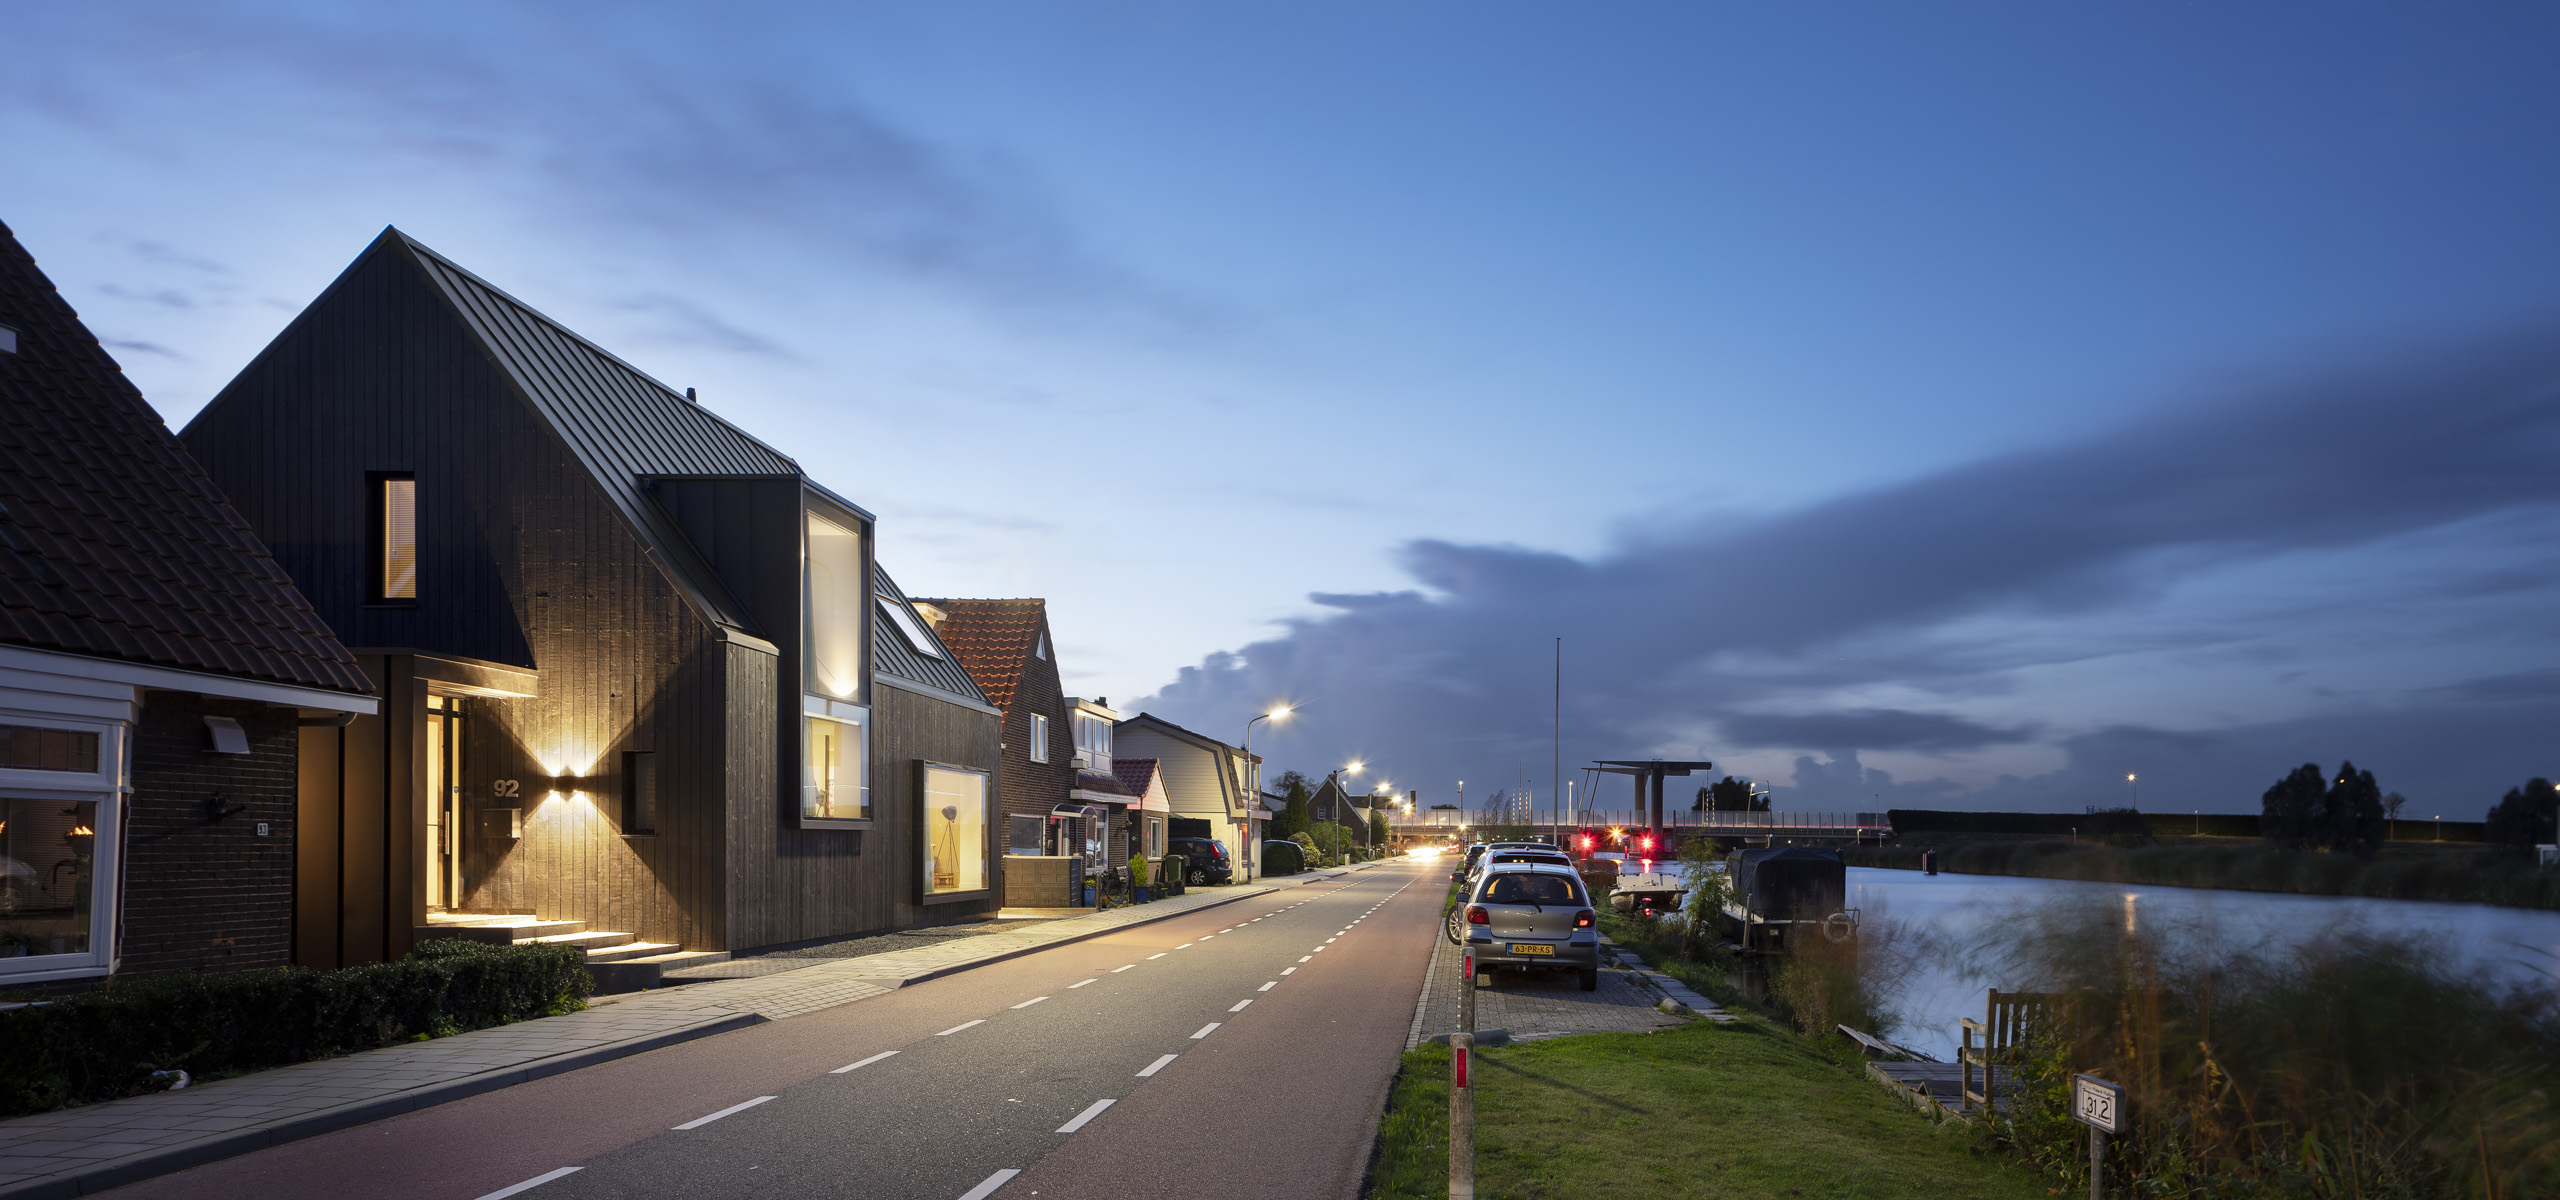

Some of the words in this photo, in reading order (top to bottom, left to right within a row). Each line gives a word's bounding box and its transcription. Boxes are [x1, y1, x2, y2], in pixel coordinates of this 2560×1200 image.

[493, 779, 519, 798] 92
[259, 824, 267, 835] 93
[1515, 945, 1550, 954] 63-PR-KS
[2086, 1096, 2111, 1120] 31,2
